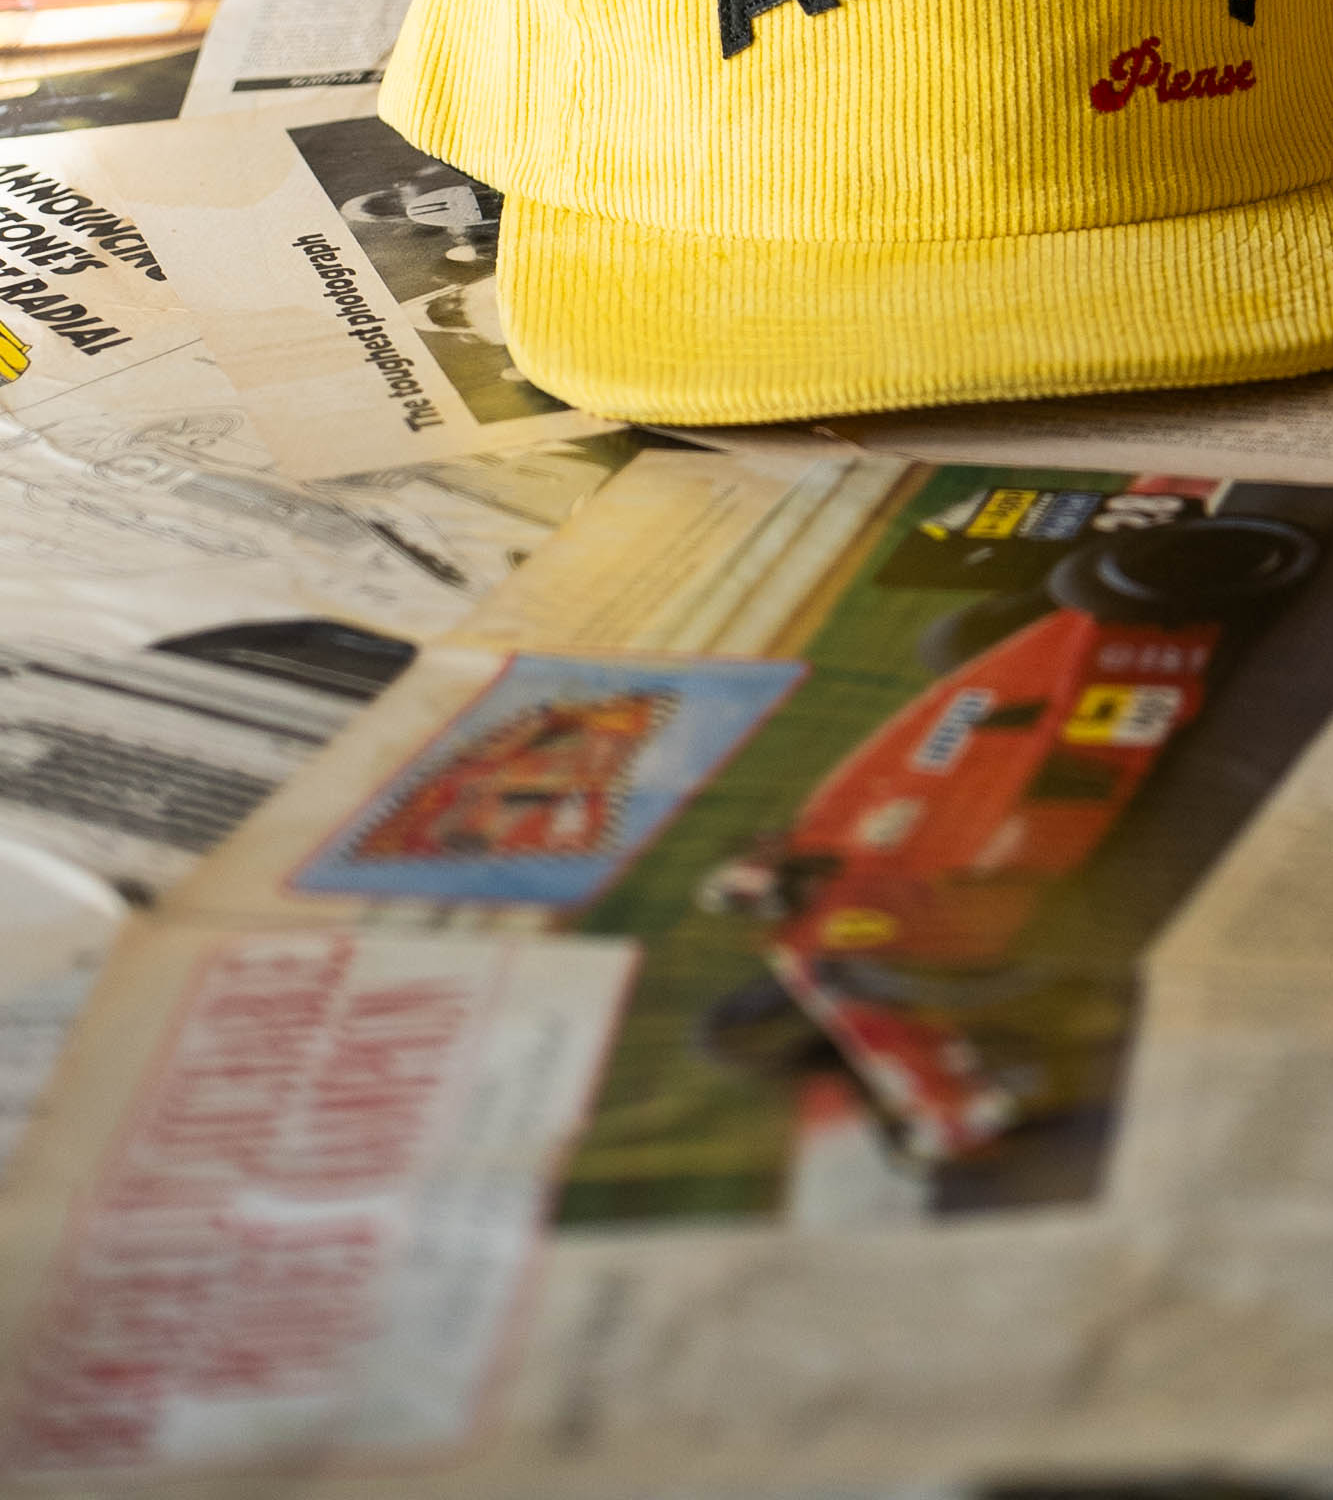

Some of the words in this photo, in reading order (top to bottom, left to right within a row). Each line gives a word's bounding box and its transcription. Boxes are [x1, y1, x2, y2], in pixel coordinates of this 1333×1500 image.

[1090, 36, 1255, 113] Please
[0, 206, 108, 275] TONE'S
[291, 232, 387, 328] photograph
[347, 323, 423, 399] toughest
[404, 396, 445, 434] The
